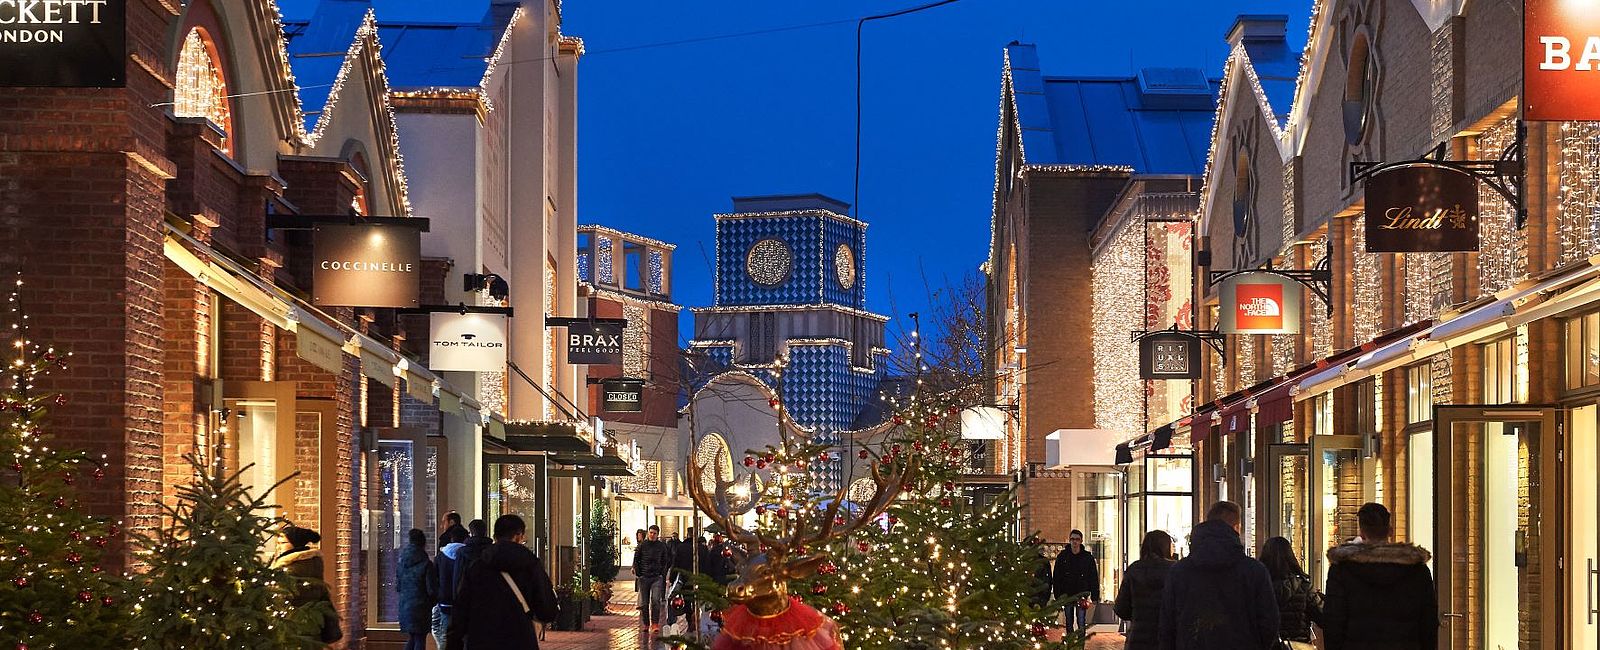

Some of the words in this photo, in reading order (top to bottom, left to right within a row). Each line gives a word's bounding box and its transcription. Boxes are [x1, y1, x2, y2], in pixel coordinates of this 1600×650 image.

[0, 29, 63, 43] NDON
[1539, 36, 1600, 71] BA
[1379, 206, 1449, 230] Lindt
[321, 260, 412, 272] COCCINELLE
[570, 334, 620, 347] BRAX
